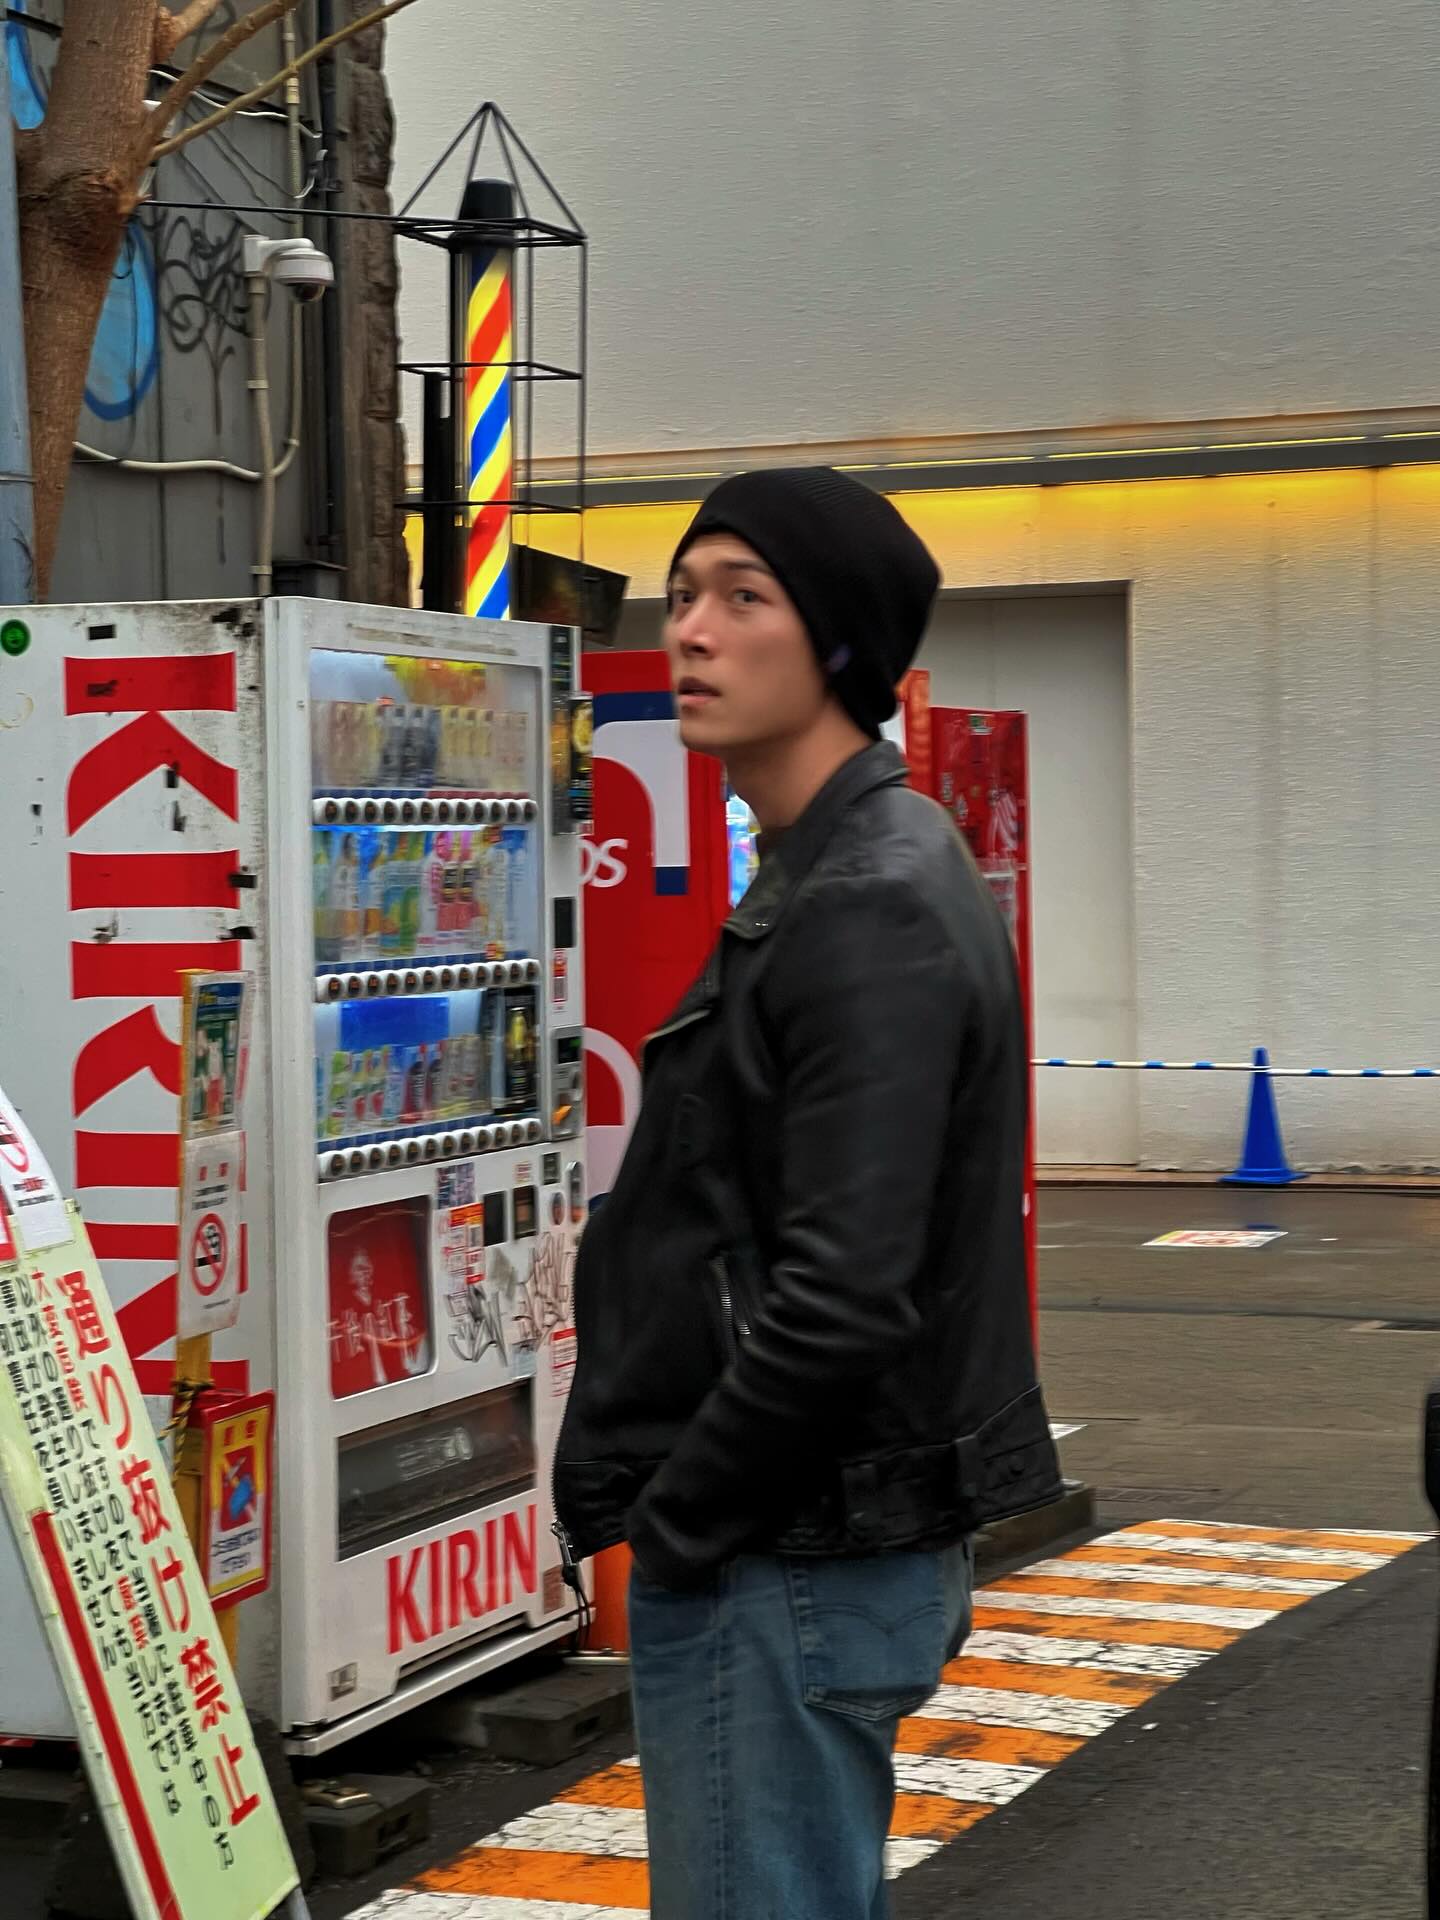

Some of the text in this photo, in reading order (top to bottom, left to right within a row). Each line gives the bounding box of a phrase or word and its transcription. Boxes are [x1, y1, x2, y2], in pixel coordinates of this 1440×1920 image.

[64, 652, 249, 1396] KIRIN
[57, 1271, 261, 1825] 通り抜け禁止
[387, 1504, 537, 1654] KIRIN
